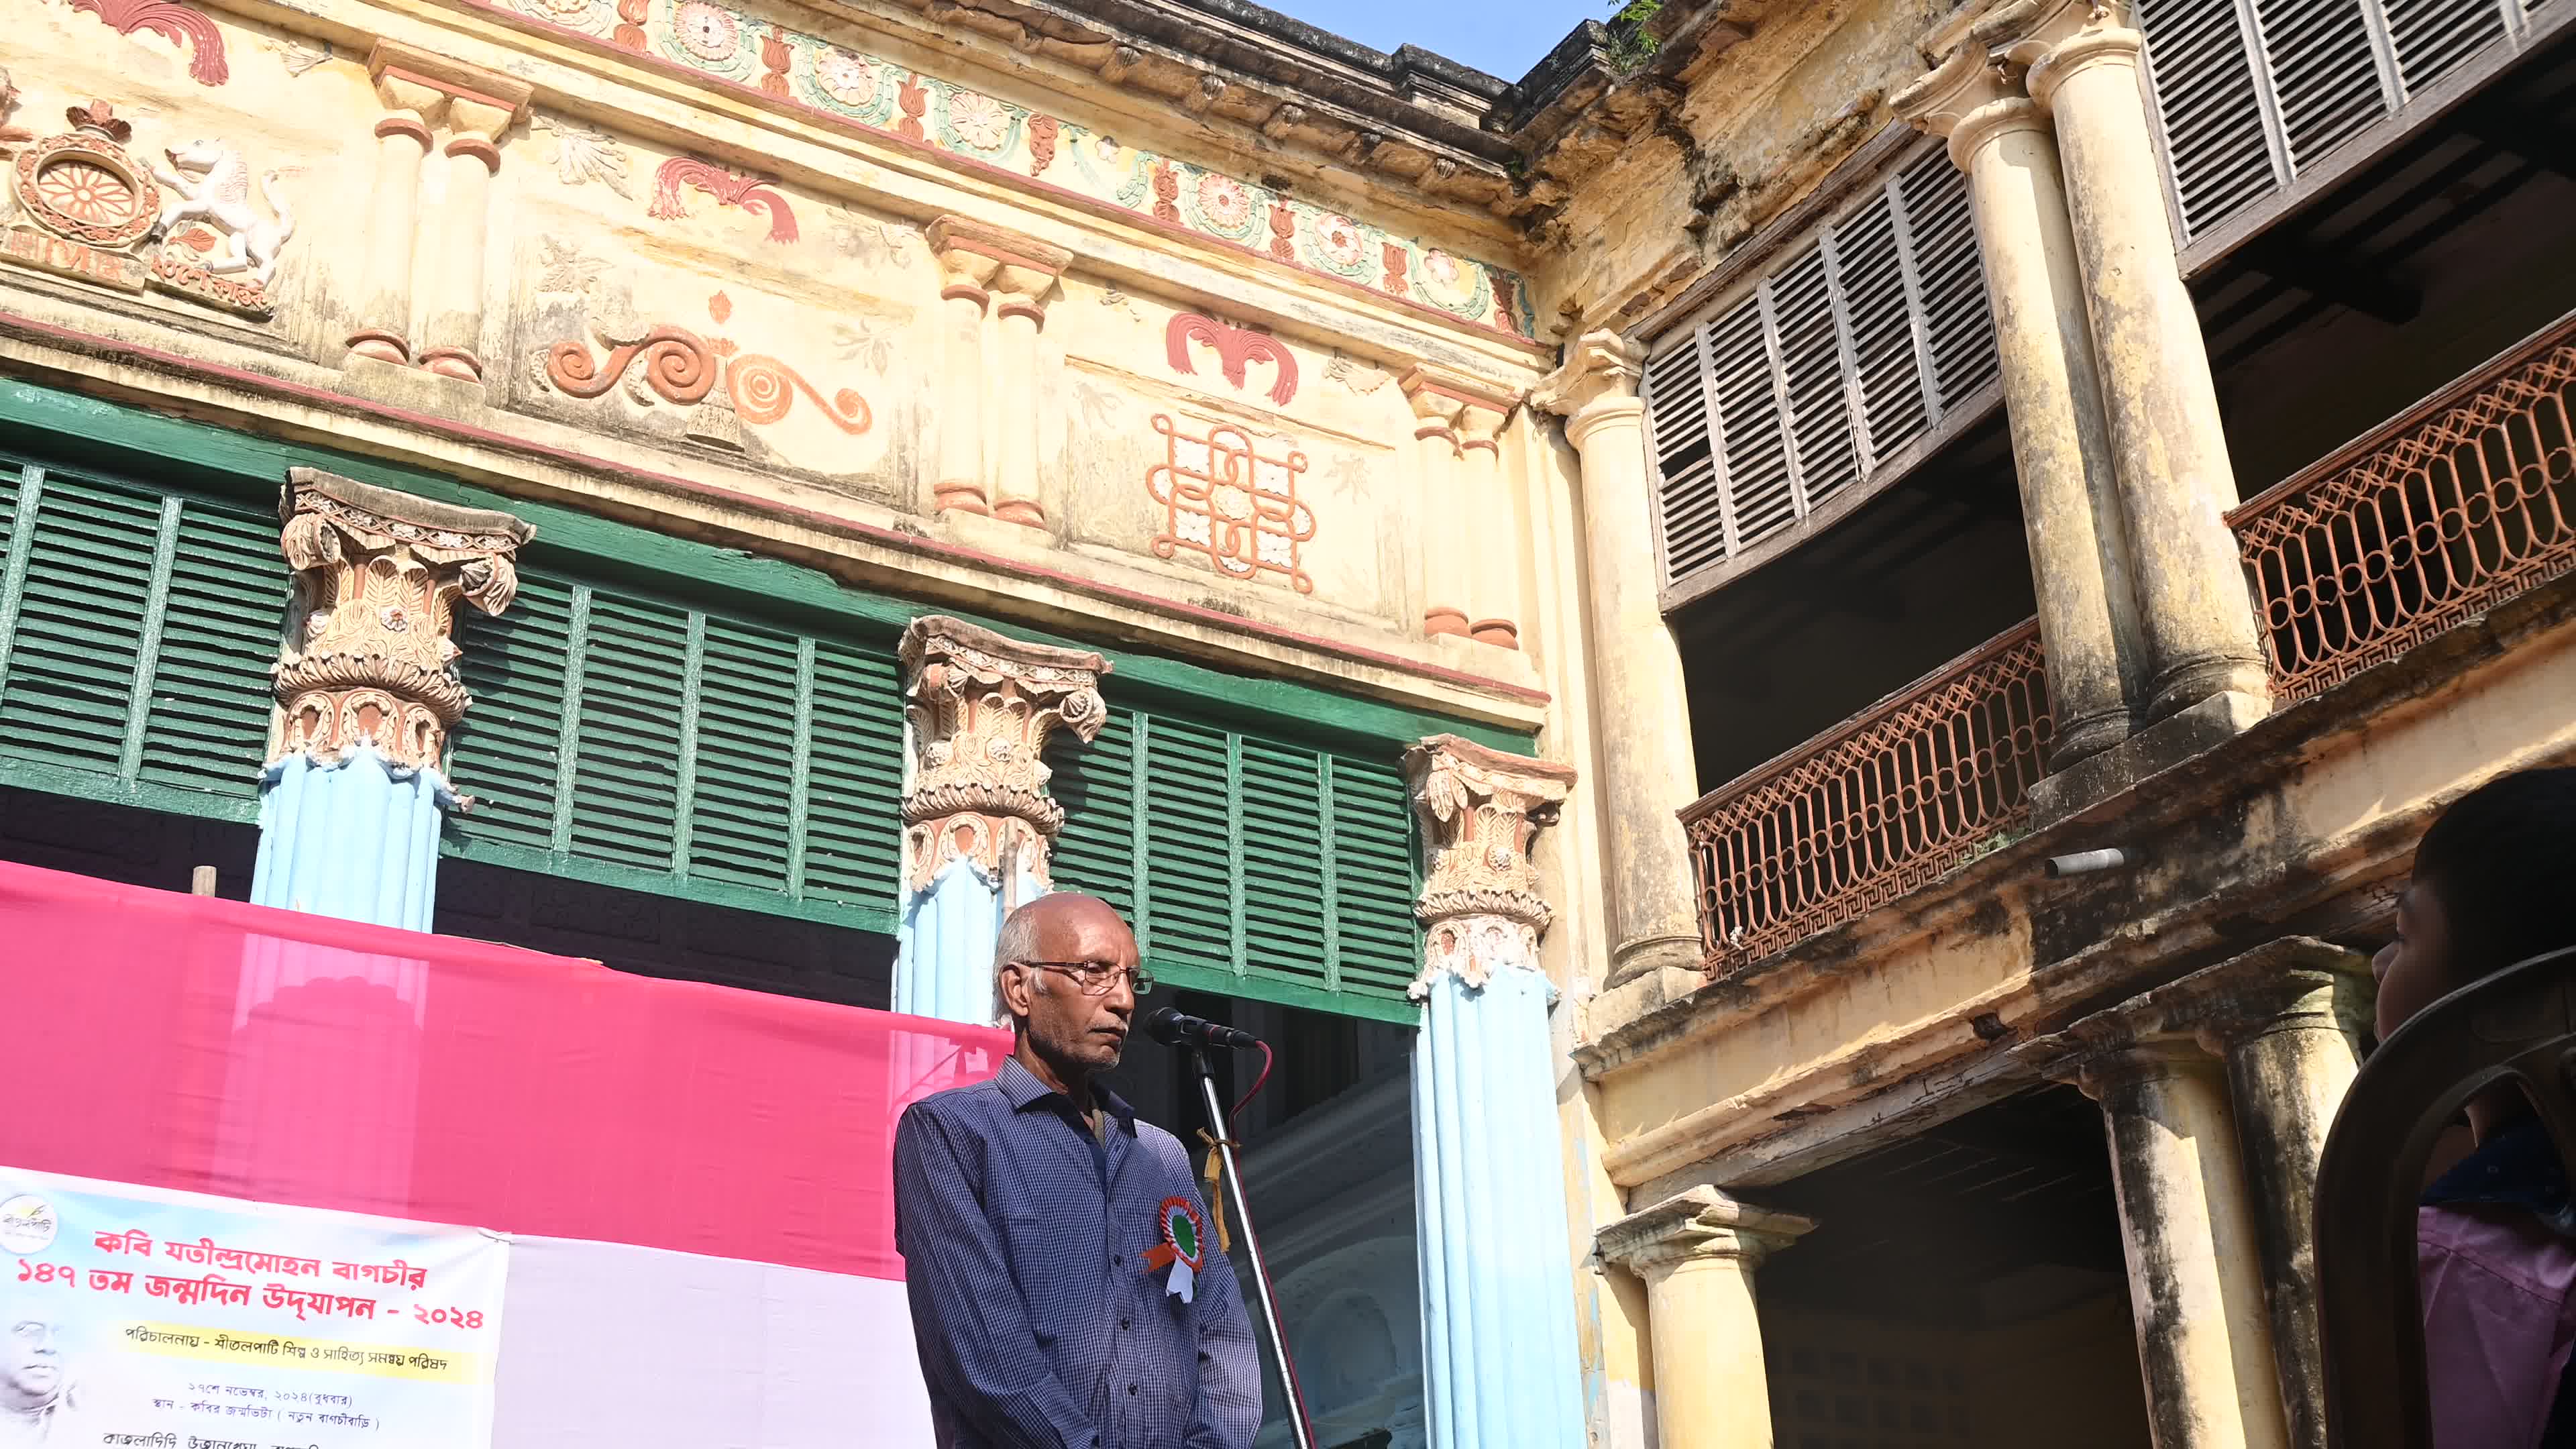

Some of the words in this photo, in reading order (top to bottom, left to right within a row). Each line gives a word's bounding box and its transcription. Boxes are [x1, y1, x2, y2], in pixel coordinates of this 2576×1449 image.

[95, 1229, 153, 1256] কবি
[164, 1238, 321, 1277] যতীন্দ্রমোহন
[332, 1259, 427, 1291] বাগচীর
[17, 1258, 76, 1287] ১৪৭
[89, 1270, 133, 1294] তম
[145, 1273, 252, 1305] জন্মদিন
[413, 1303, 484, 1330] ২০২৪
[125, 1326, 201, 1348] পরিচালনায়
[214, 1334, 280, 1355] শীতলপাটি
[282, 1340, 306, 1359] শিল্প
[310, 1347, 319, 1358] ও
[323, 1346, 364, 1365] সাহিত্য
[368, 1352, 405, 1367] সমন্বয়
[408, 1352, 449, 1370] পরিষদ
[190, 1400, 221, 1413] কবির
[225, 1404, 273, 1418] জন্মভিটা
[288, 1411, 313, 1423] নতুন
[103, 1432, 178, 1449] কাজলাদিদি
